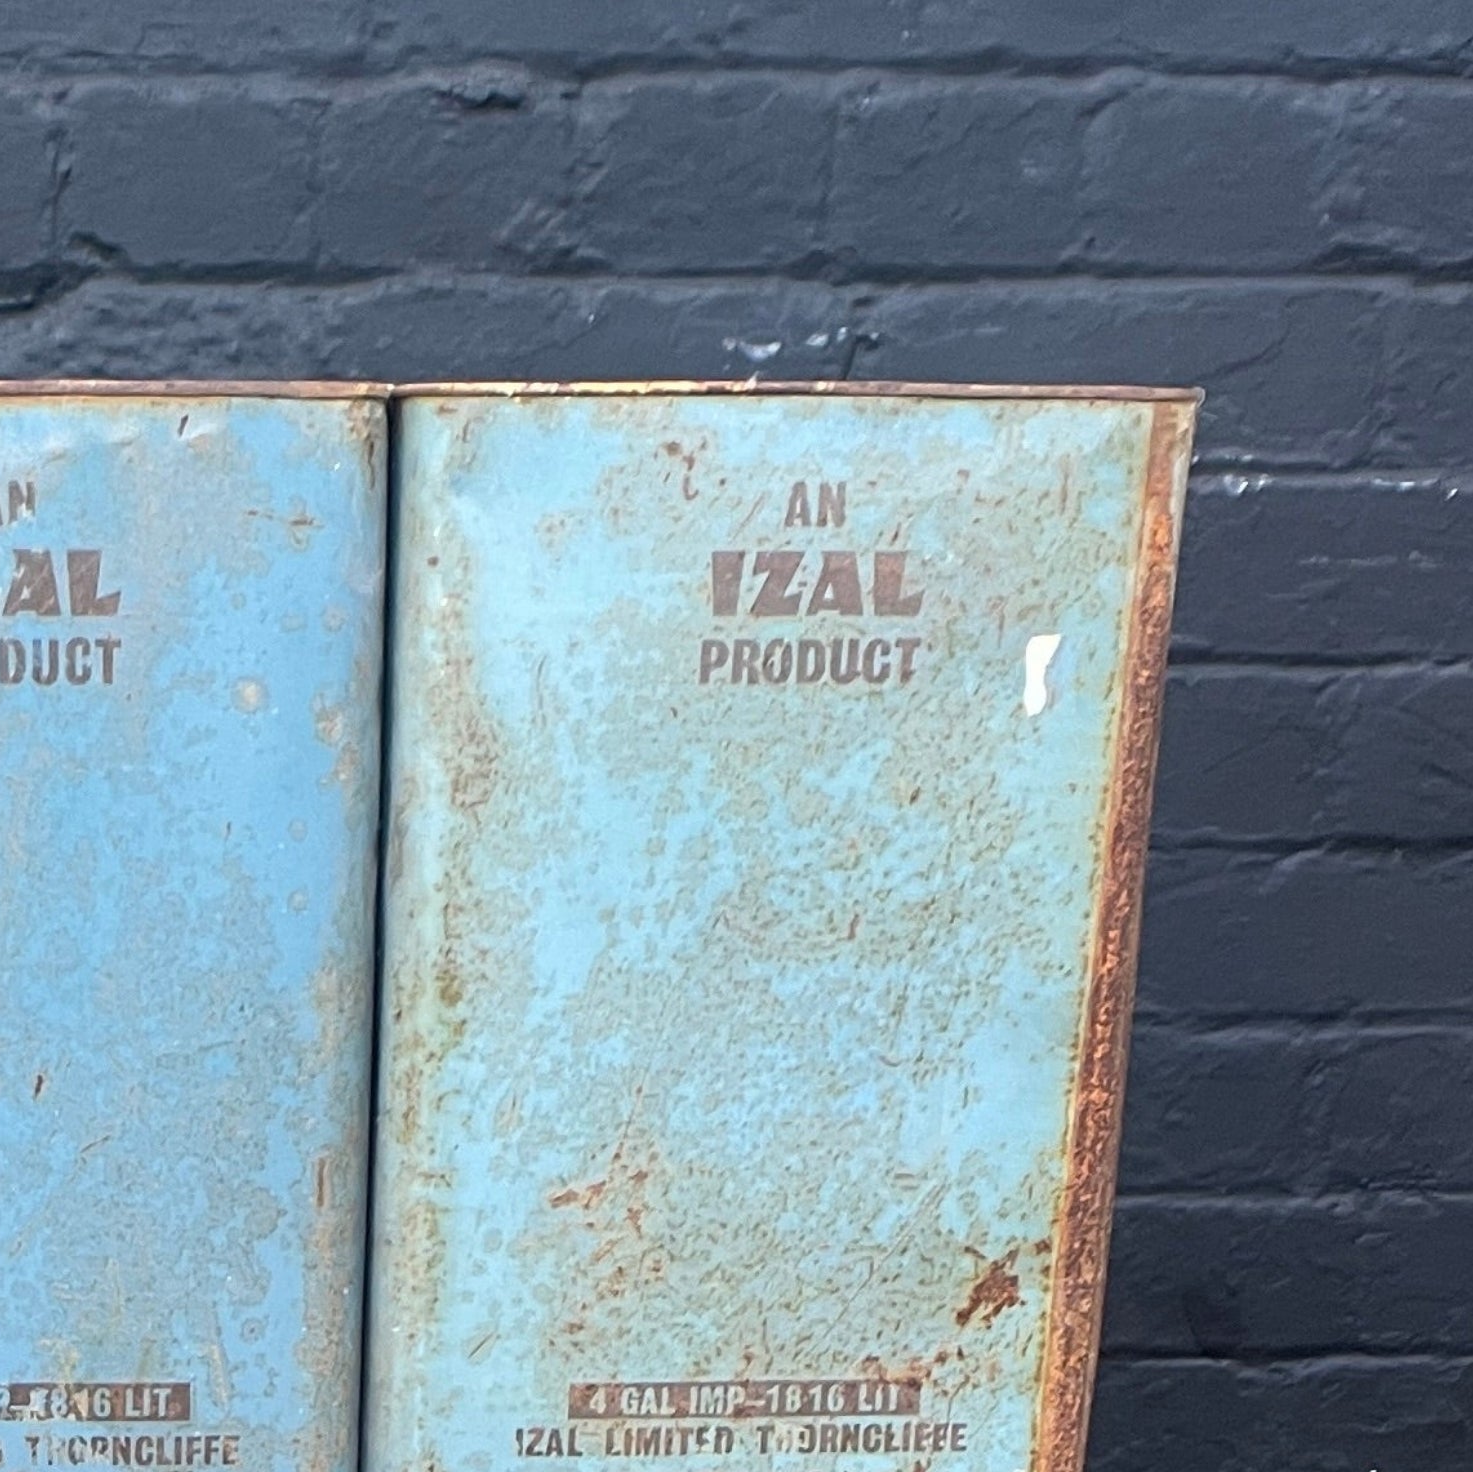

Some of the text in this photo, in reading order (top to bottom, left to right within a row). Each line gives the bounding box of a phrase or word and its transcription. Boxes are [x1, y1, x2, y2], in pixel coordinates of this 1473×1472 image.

[784, 481, 846, 527] AN
[712, 551, 924, 616] IZAL
[699, 637, 921, 684] PRODUCT
[125, 1387, 172, 1417] LIT
[589, 1386, 606, 1414] 4
[621, 1386, 676, 1415] GAL
[857, 1384, 899, 1412] LIT
[25, 1435, 240, 1466] THORNCLIFFE
[516, 1427, 583, 1457] IZAL
[605, 1426, 734, 1456] LIMITED
